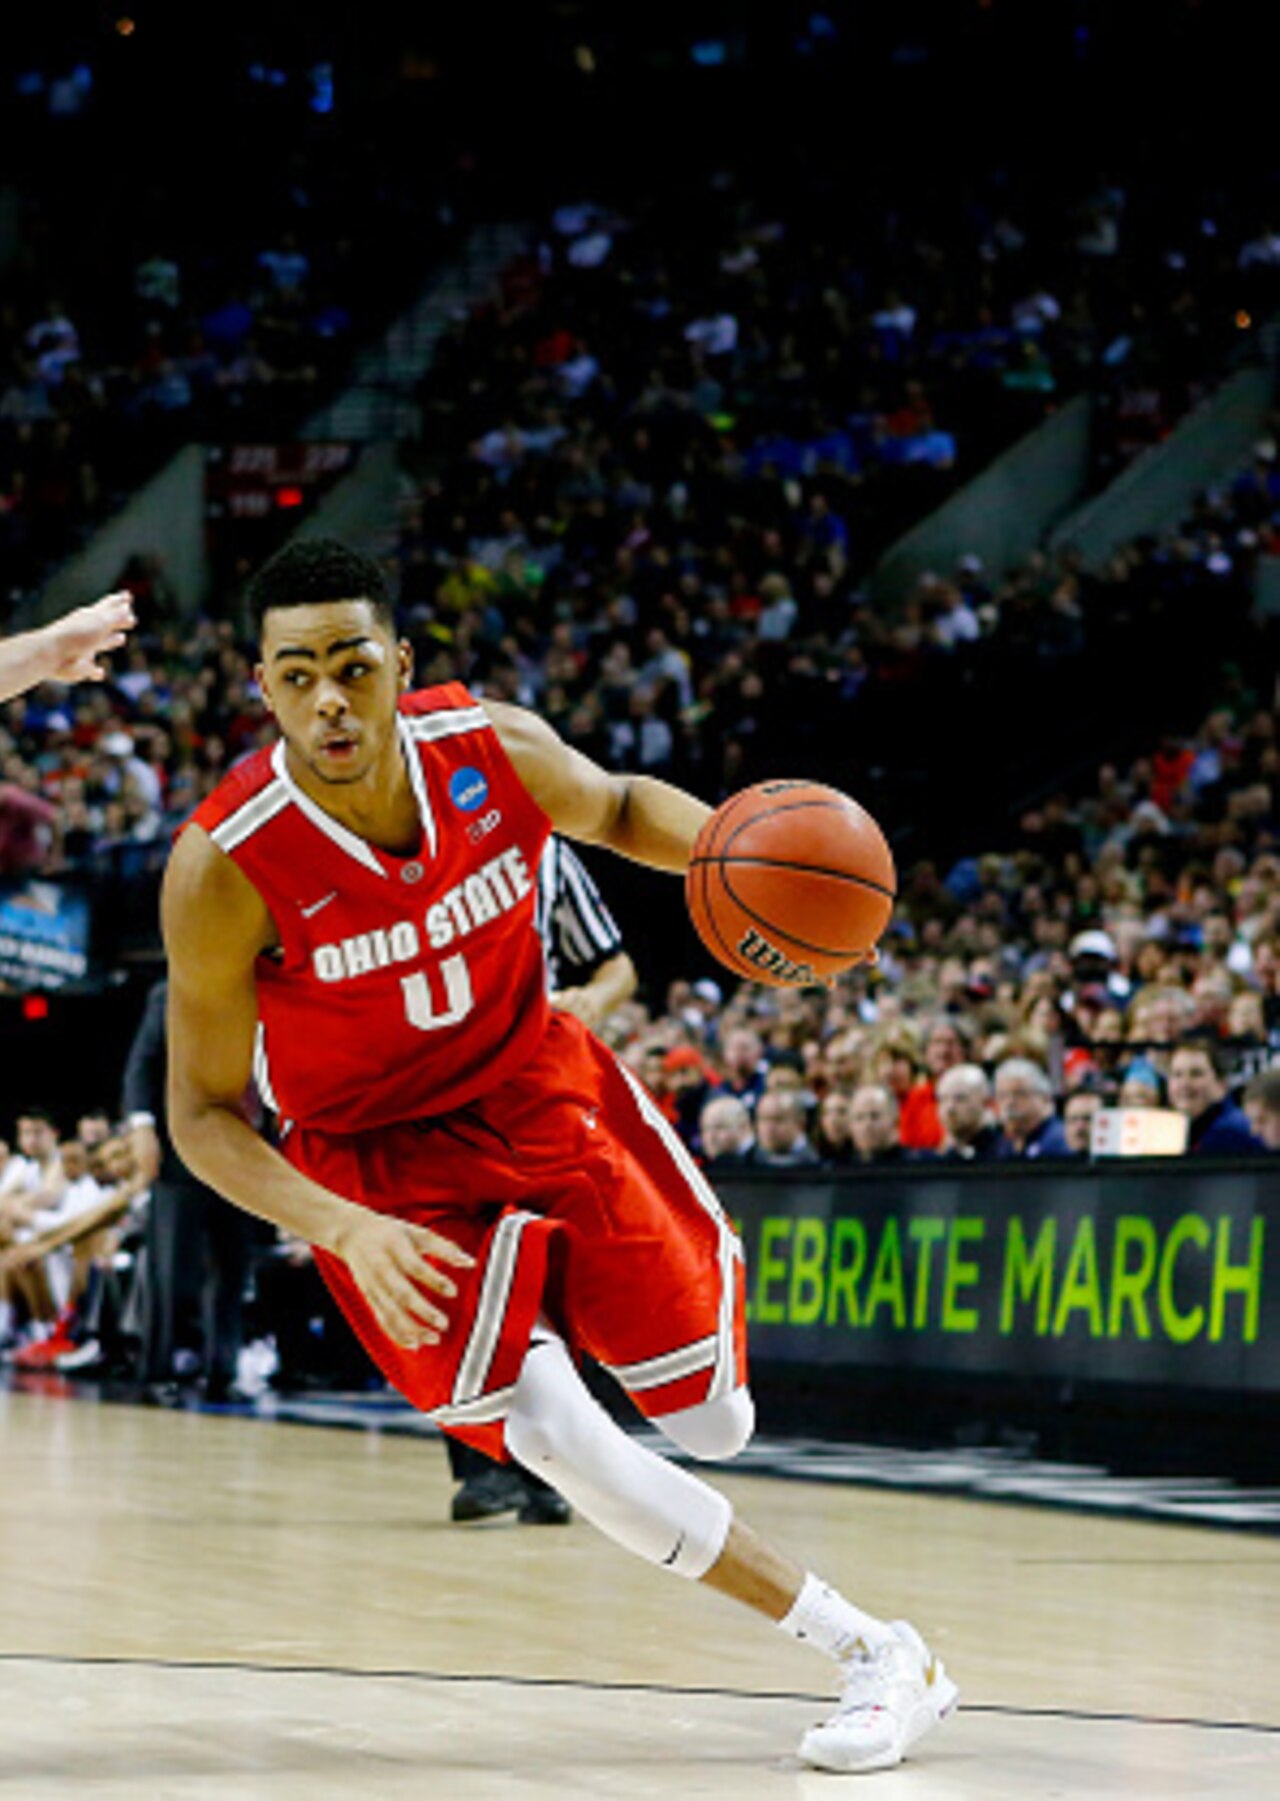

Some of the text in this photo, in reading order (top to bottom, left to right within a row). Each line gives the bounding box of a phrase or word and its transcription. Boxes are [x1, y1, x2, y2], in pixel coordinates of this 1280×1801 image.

[313, 844, 533, 982] OHIO STATE
[999, 1215, 1264, 1342] MARCH
